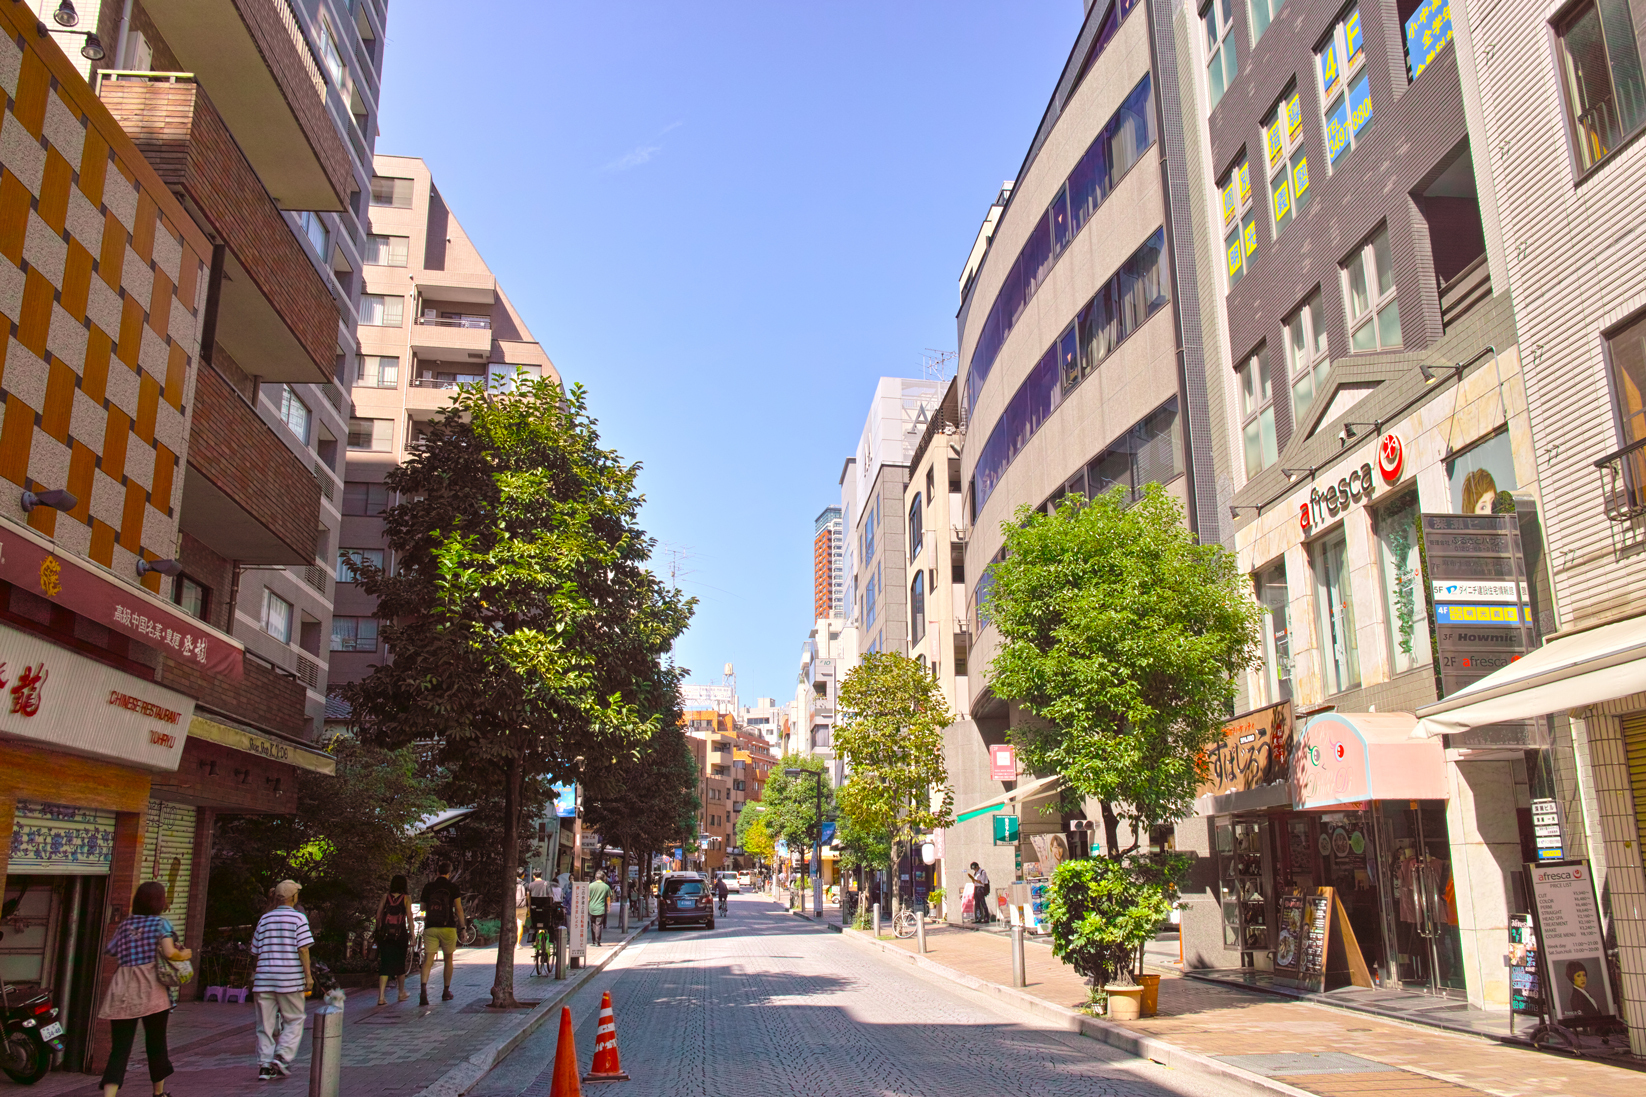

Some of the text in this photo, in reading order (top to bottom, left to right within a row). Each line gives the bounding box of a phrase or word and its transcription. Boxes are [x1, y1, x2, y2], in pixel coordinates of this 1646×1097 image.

[1327, 118, 1341, 139] TEL
[1299, 462, 1374, 530] afresca
[1433, 586, 1443, 594] 5F
[1438, 607, 1448, 615] 4F
[1458, 633, 1517, 642] Howmic
[1444, 656, 1508, 668] 2F afresca
[109, 690, 182, 726] CHINESE RESTAURANT
[1538, 871, 1572, 882] afresca
